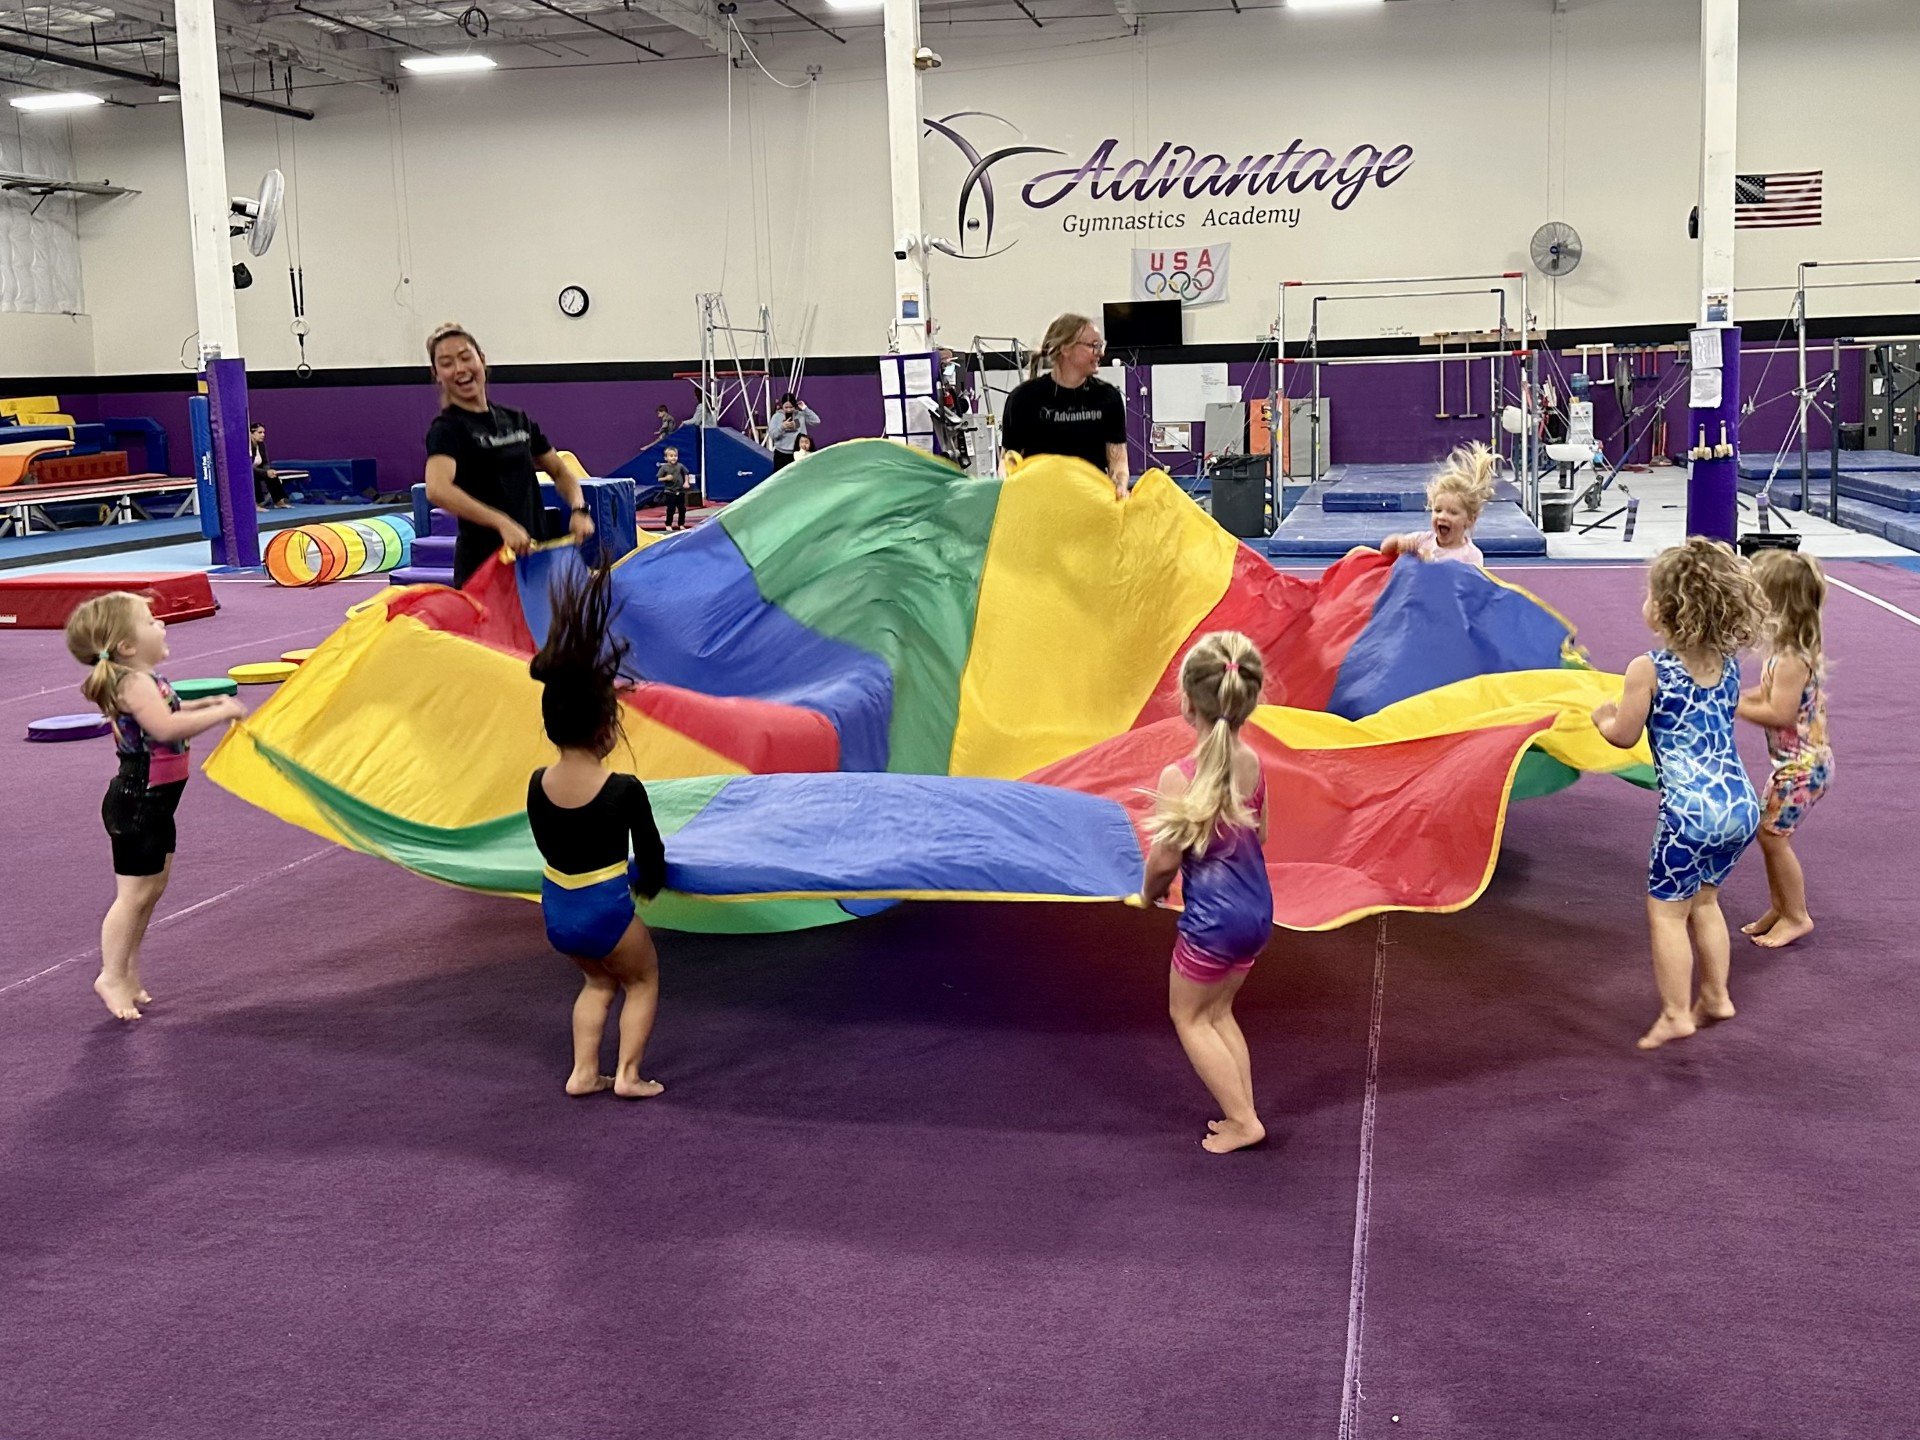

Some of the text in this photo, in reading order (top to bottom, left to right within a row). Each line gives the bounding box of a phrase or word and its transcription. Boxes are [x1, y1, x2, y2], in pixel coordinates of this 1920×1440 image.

[1022, 138, 1414, 210] Advantage
[1062, 206, 1301, 237] Gymnastics Academy
